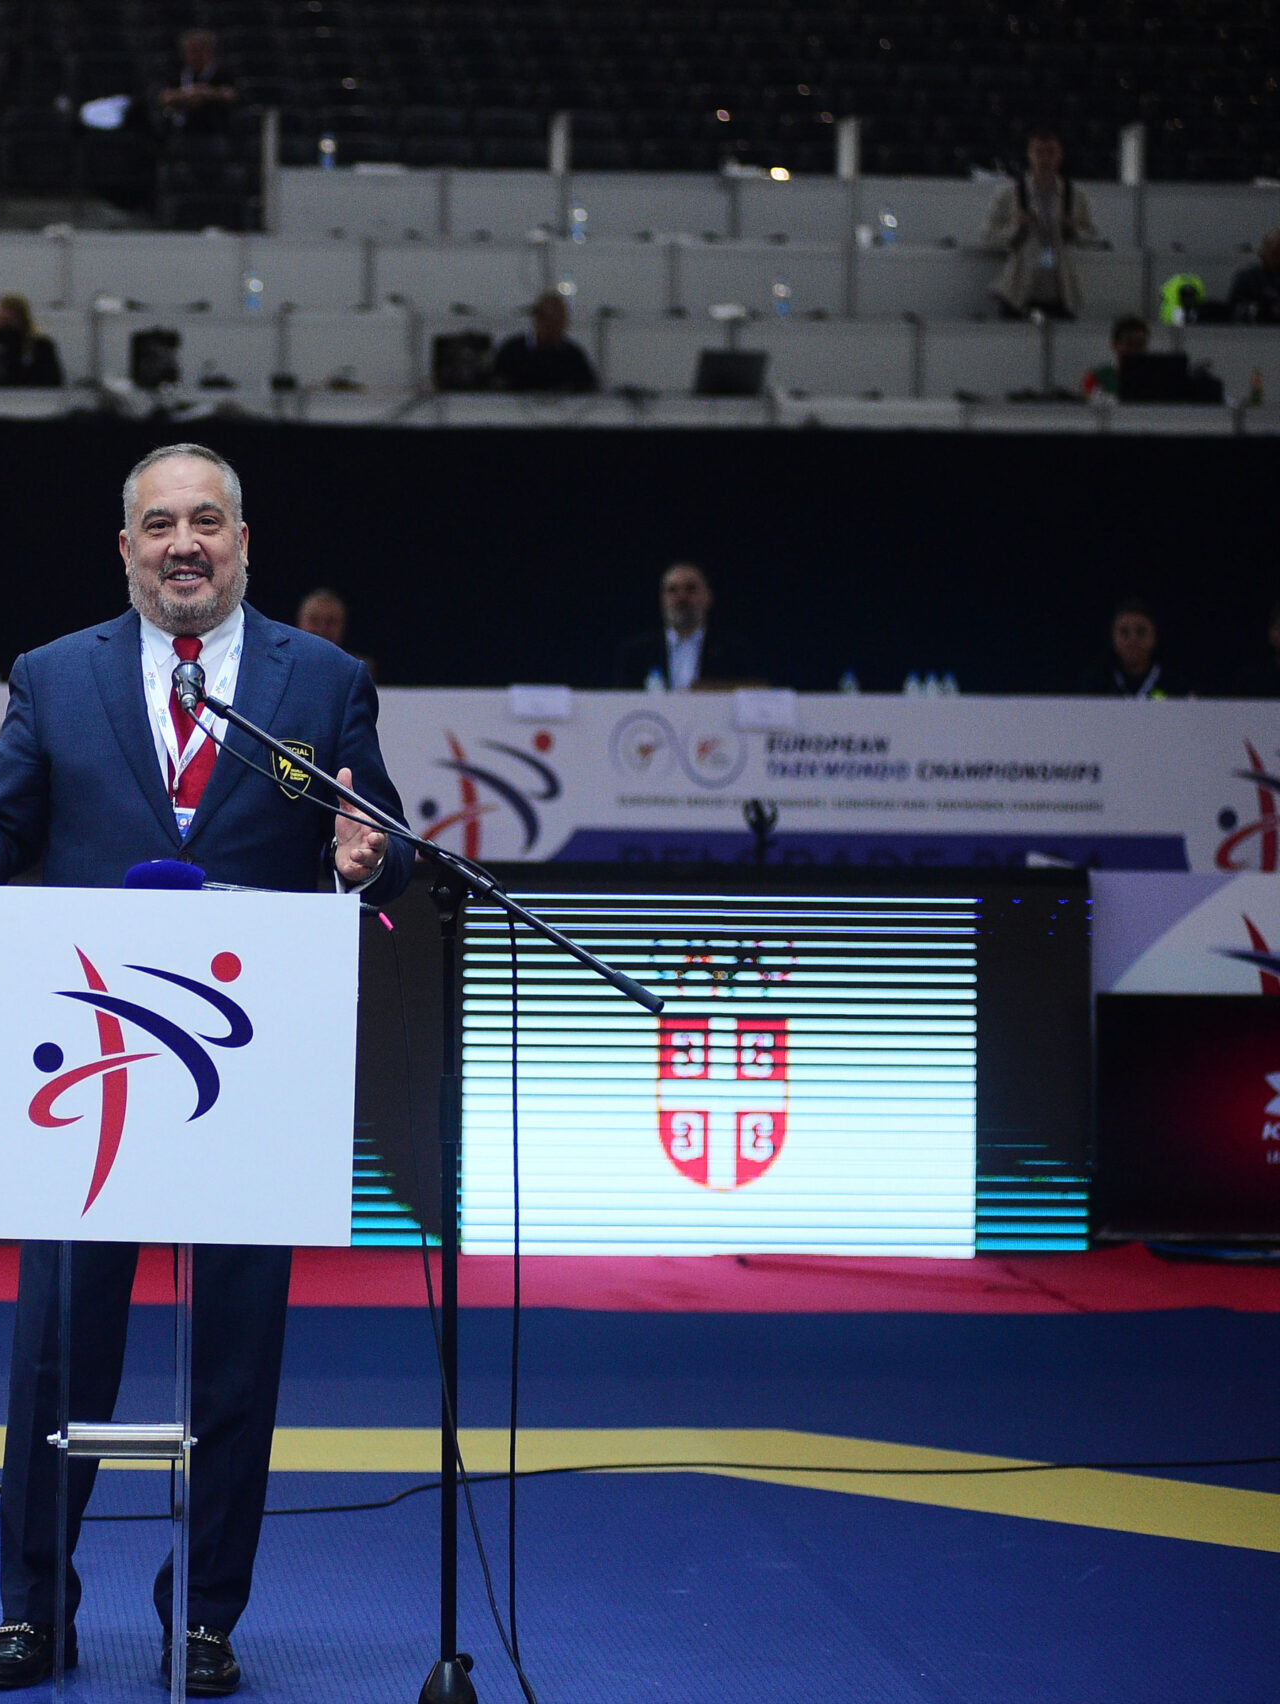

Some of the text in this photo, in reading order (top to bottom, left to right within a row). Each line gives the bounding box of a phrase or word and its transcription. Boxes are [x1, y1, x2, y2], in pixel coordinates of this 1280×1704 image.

[766, 735, 890, 754] EUROPEAN
[766, 760, 1103, 784] TAEKWONDO CHAMPIONSHIPS
